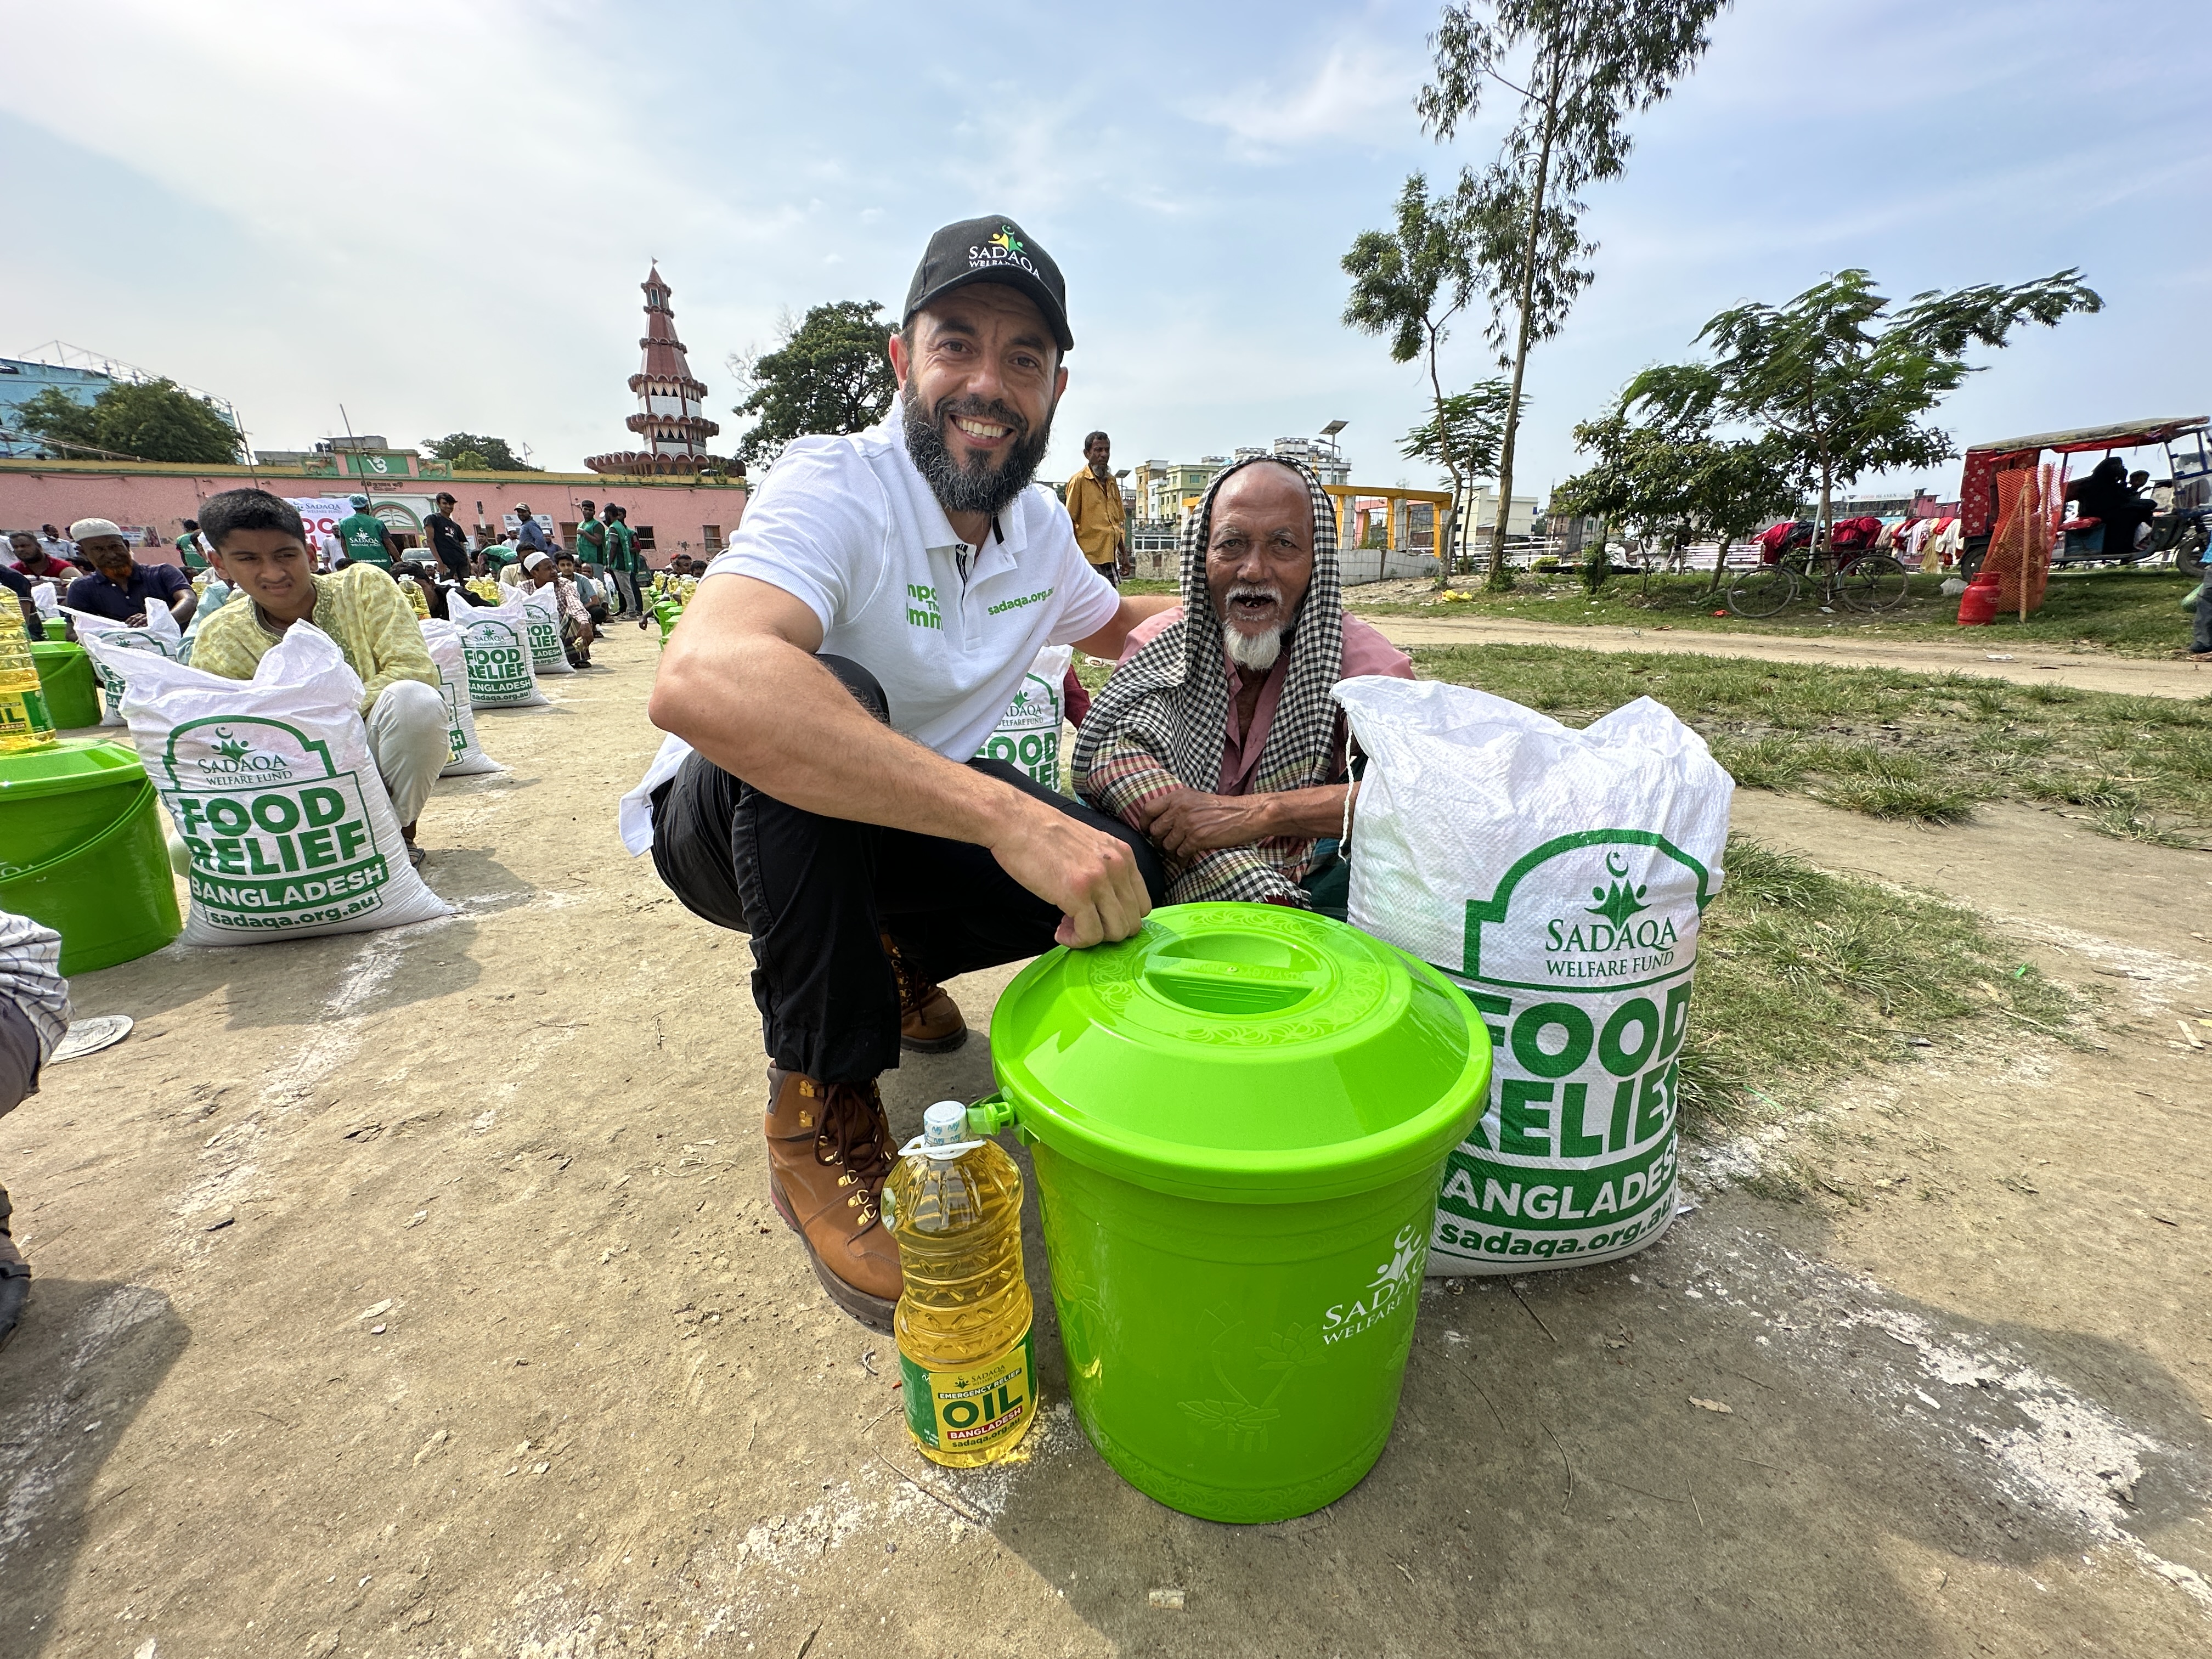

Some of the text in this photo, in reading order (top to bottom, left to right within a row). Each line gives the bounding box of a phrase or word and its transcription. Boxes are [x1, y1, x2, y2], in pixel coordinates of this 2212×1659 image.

[968, 246, 1040, 280] SADAQA
[464, 648, 521, 664] FOOD
[528, 635, 557, 647] LIEF
[532, 649, 561, 658] LADESH
[466, 662, 524, 679] RELIEF
[472, 691, 528, 701] sadaqa.org.au
[198, 754, 289, 774] SADAQA
[206, 770, 292, 787] WELFARE FUND
[178, 787, 346, 837] FOOD
[182, 820, 366, 876] RELIEF
[191, 863, 386, 906] BANGLADESH
[211, 895, 374, 929] sadaqa.org.au
[1545, 917, 1679, 952] SADAQA
[1545, 951, 1674, 978] WELFARE FUND
[1441, 1137, 1677, 1220] ANGLADES
[1439, 1192, 1673, 1258] sadaqa.org.au
[1323, 1246, 1426, 1330] SADAQ
[1322, 1291, 1403, 1345] WELFARE
[940, 1368, 1020, 1399] EMERGENCY RELIEF
[972, 1364, 1005, 1382] SADAQA
[943, 1384, 1023, 1429] OIL
[950, 1407, 1021, 1439] BANGLADESH
[952, 1418, 1020, 1447] sadaqa.org.au
